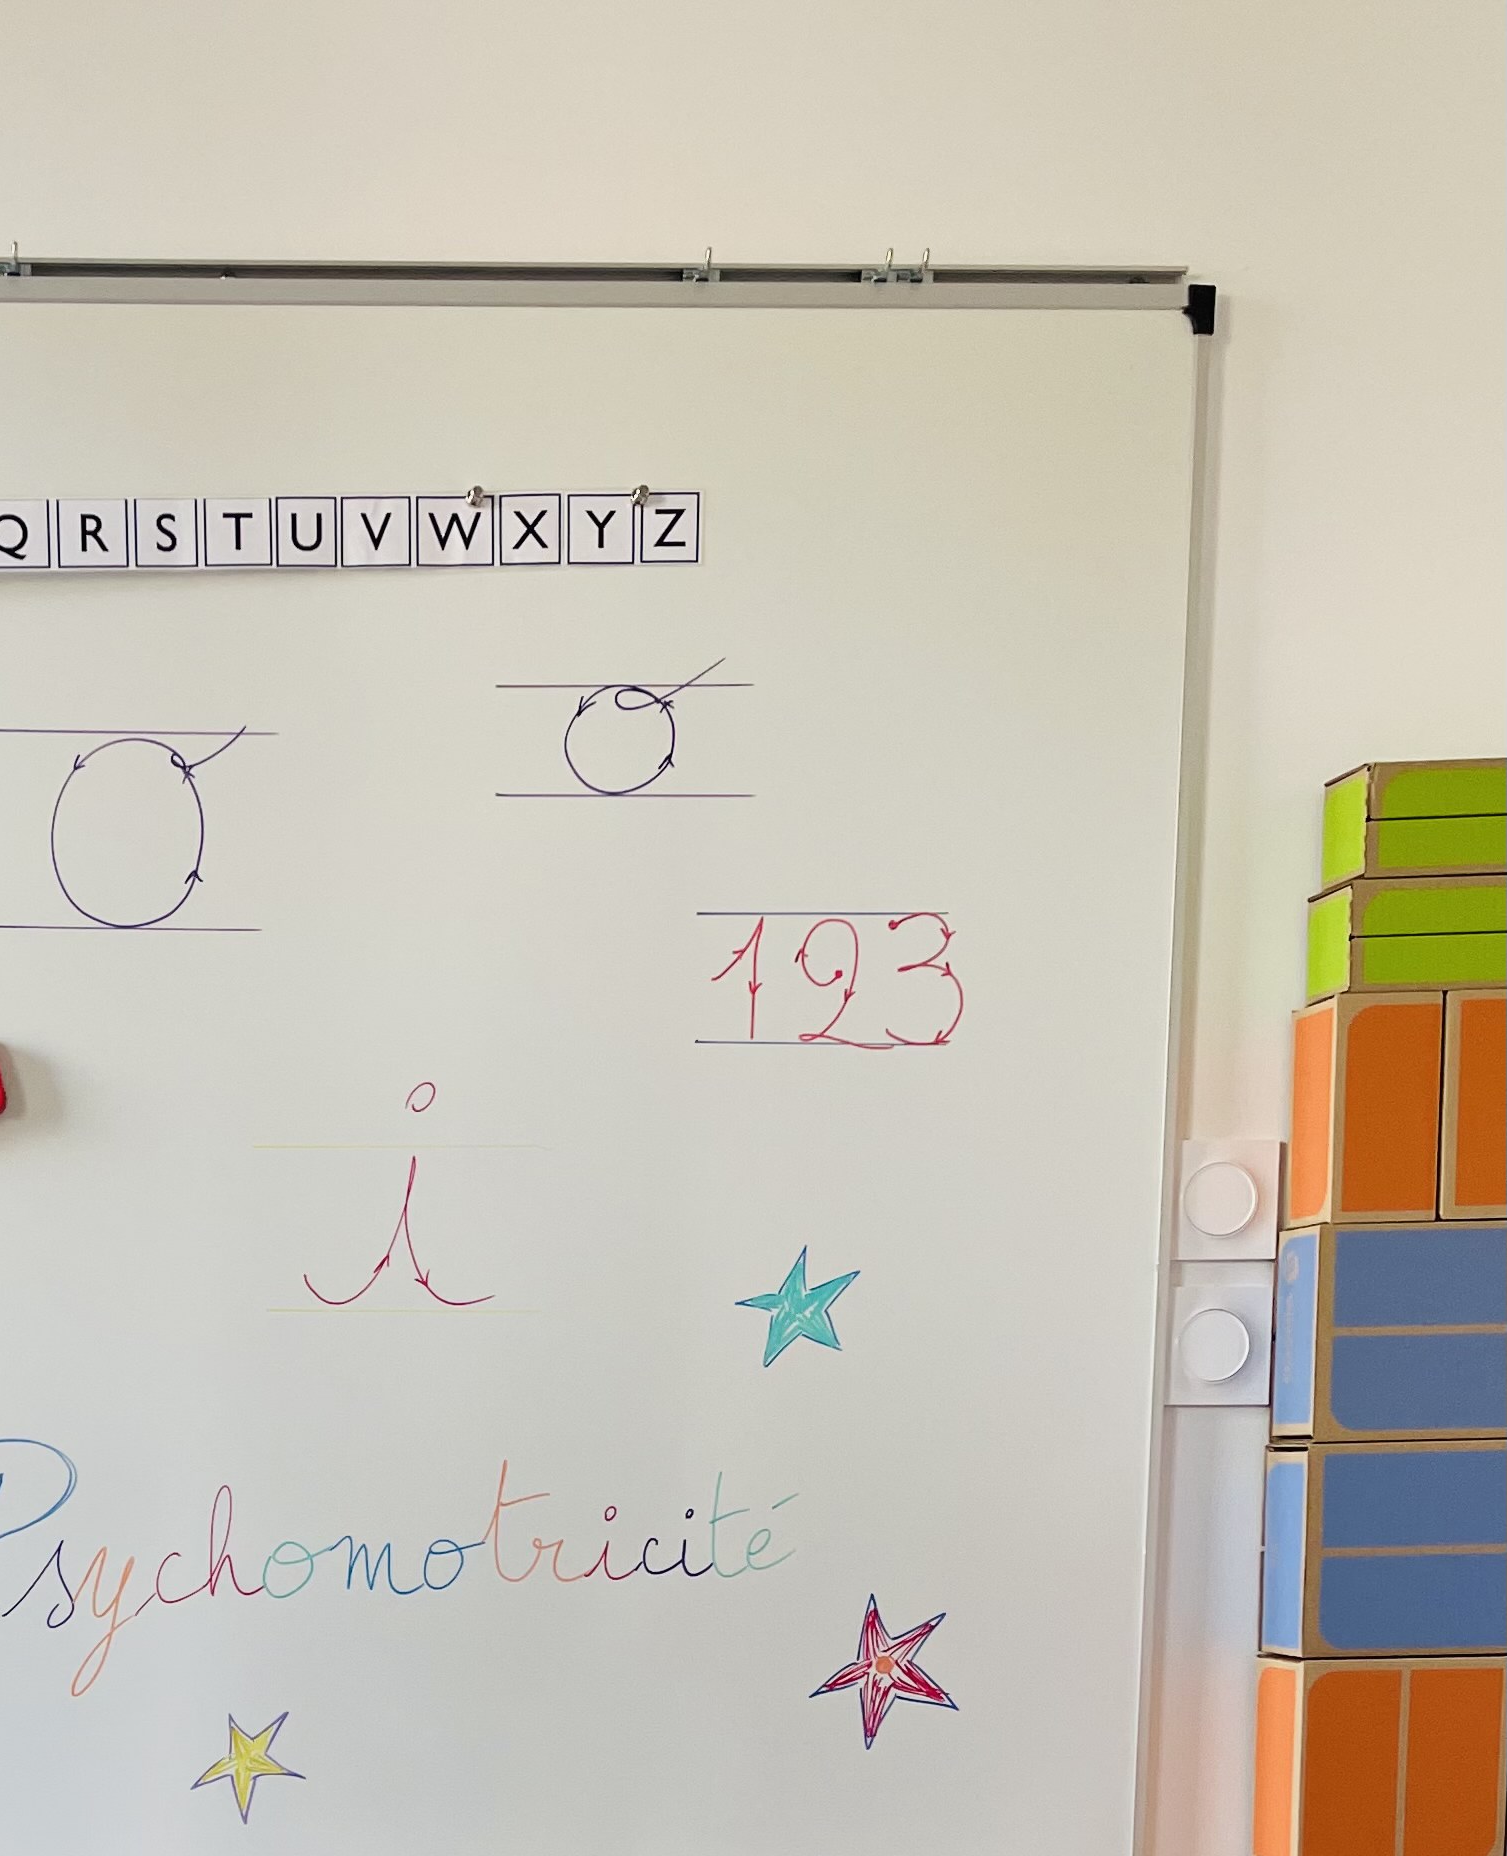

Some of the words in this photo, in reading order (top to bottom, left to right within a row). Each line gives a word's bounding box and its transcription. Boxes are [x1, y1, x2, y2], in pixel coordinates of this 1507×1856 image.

[80, 513, 109, 553] R
[156, 513, 177, 552] S
[222, 512, 253, 551] T
[290, 512, 323, 552] U
[360, 512, 392, 551] V
[428, 511, 482, 551] W
[512, 509, 549, 550] X
[585, 510, 616, 549] Y
[653, 508, 687, 548] Z
